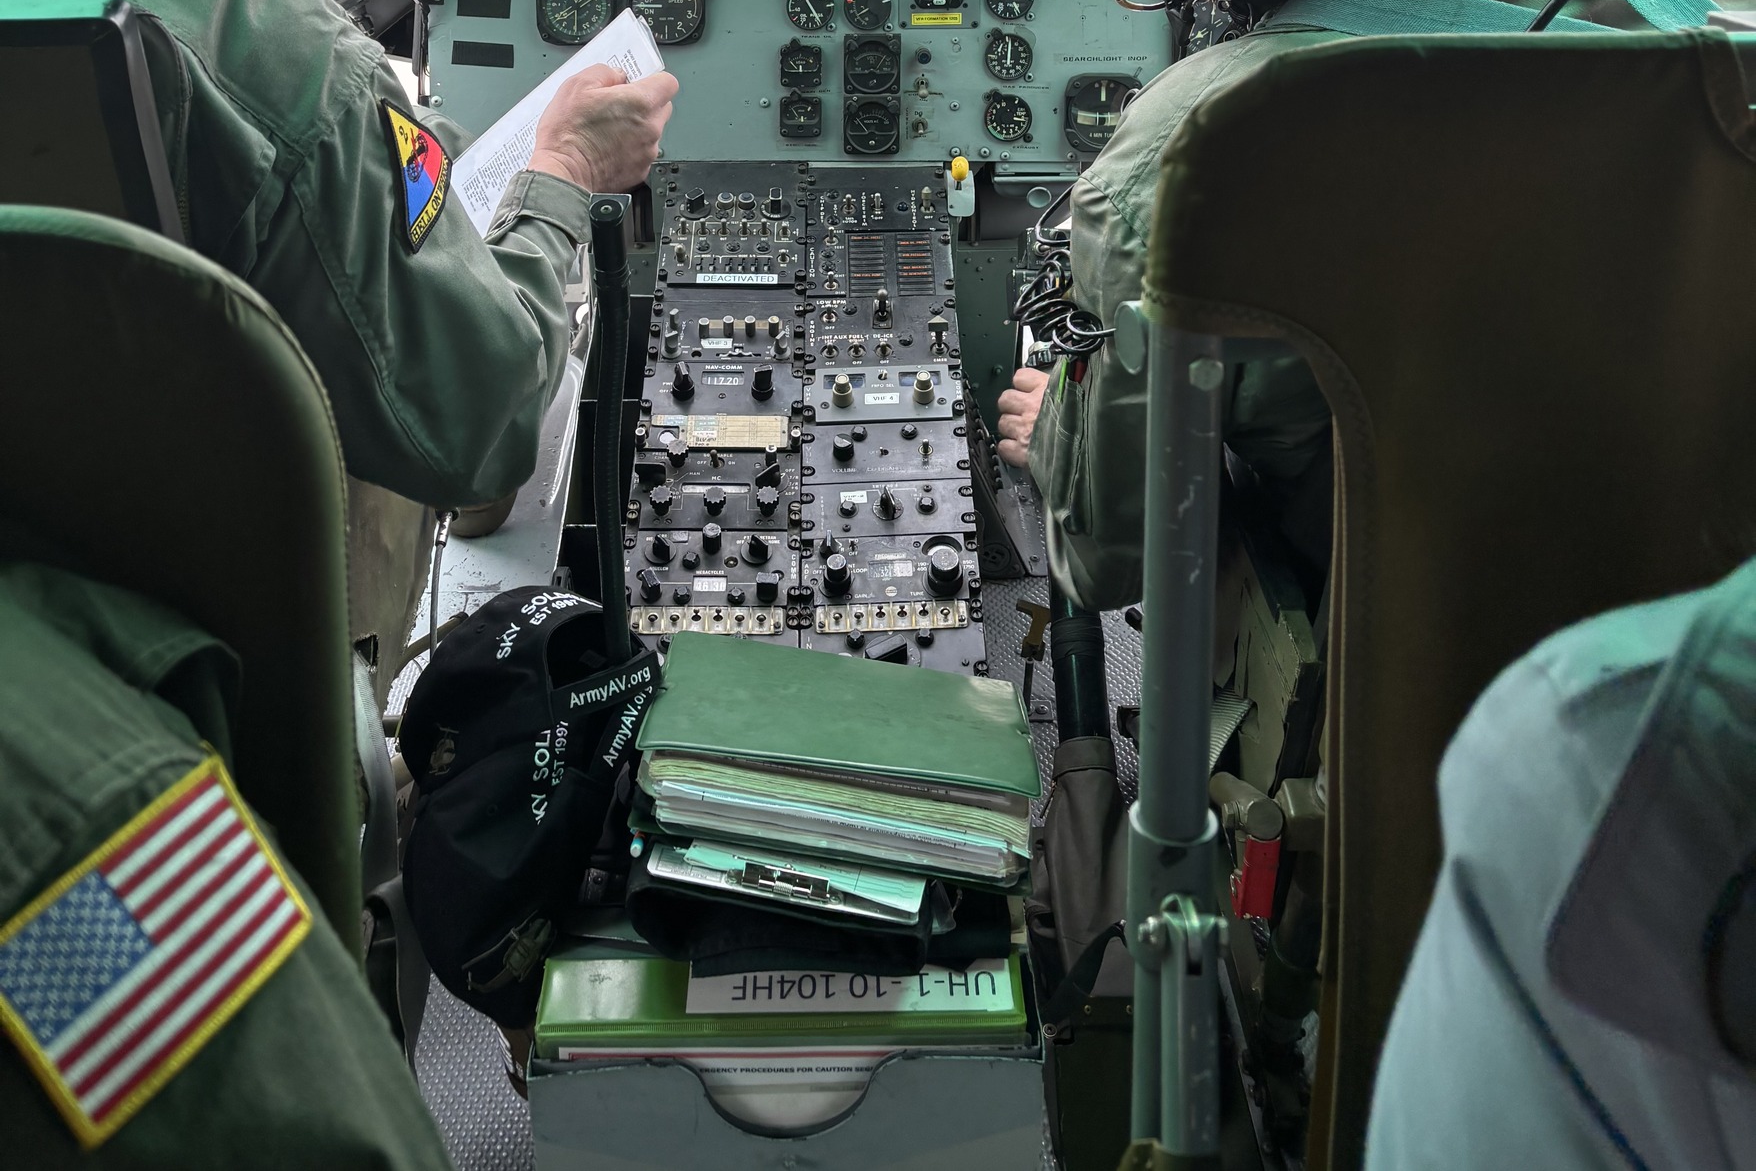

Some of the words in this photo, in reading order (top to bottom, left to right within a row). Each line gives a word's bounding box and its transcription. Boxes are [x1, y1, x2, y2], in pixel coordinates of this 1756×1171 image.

[411, 210, 434, 244] HELL
[431, 194, 442, 210] ON
[529, 606, 552, 626] EST
[496, 622, 521, 661] SKY
[569, 665, 651, 709] ArmyAV.org
[551, 759, 565, 786] EST
[530, 793, 548, 825] KY
[731, 973, 836, 1001] 104HF
[918, 971, 997, 998] UH-1
[740, 1066, 795, 1074] PROCEDURES
